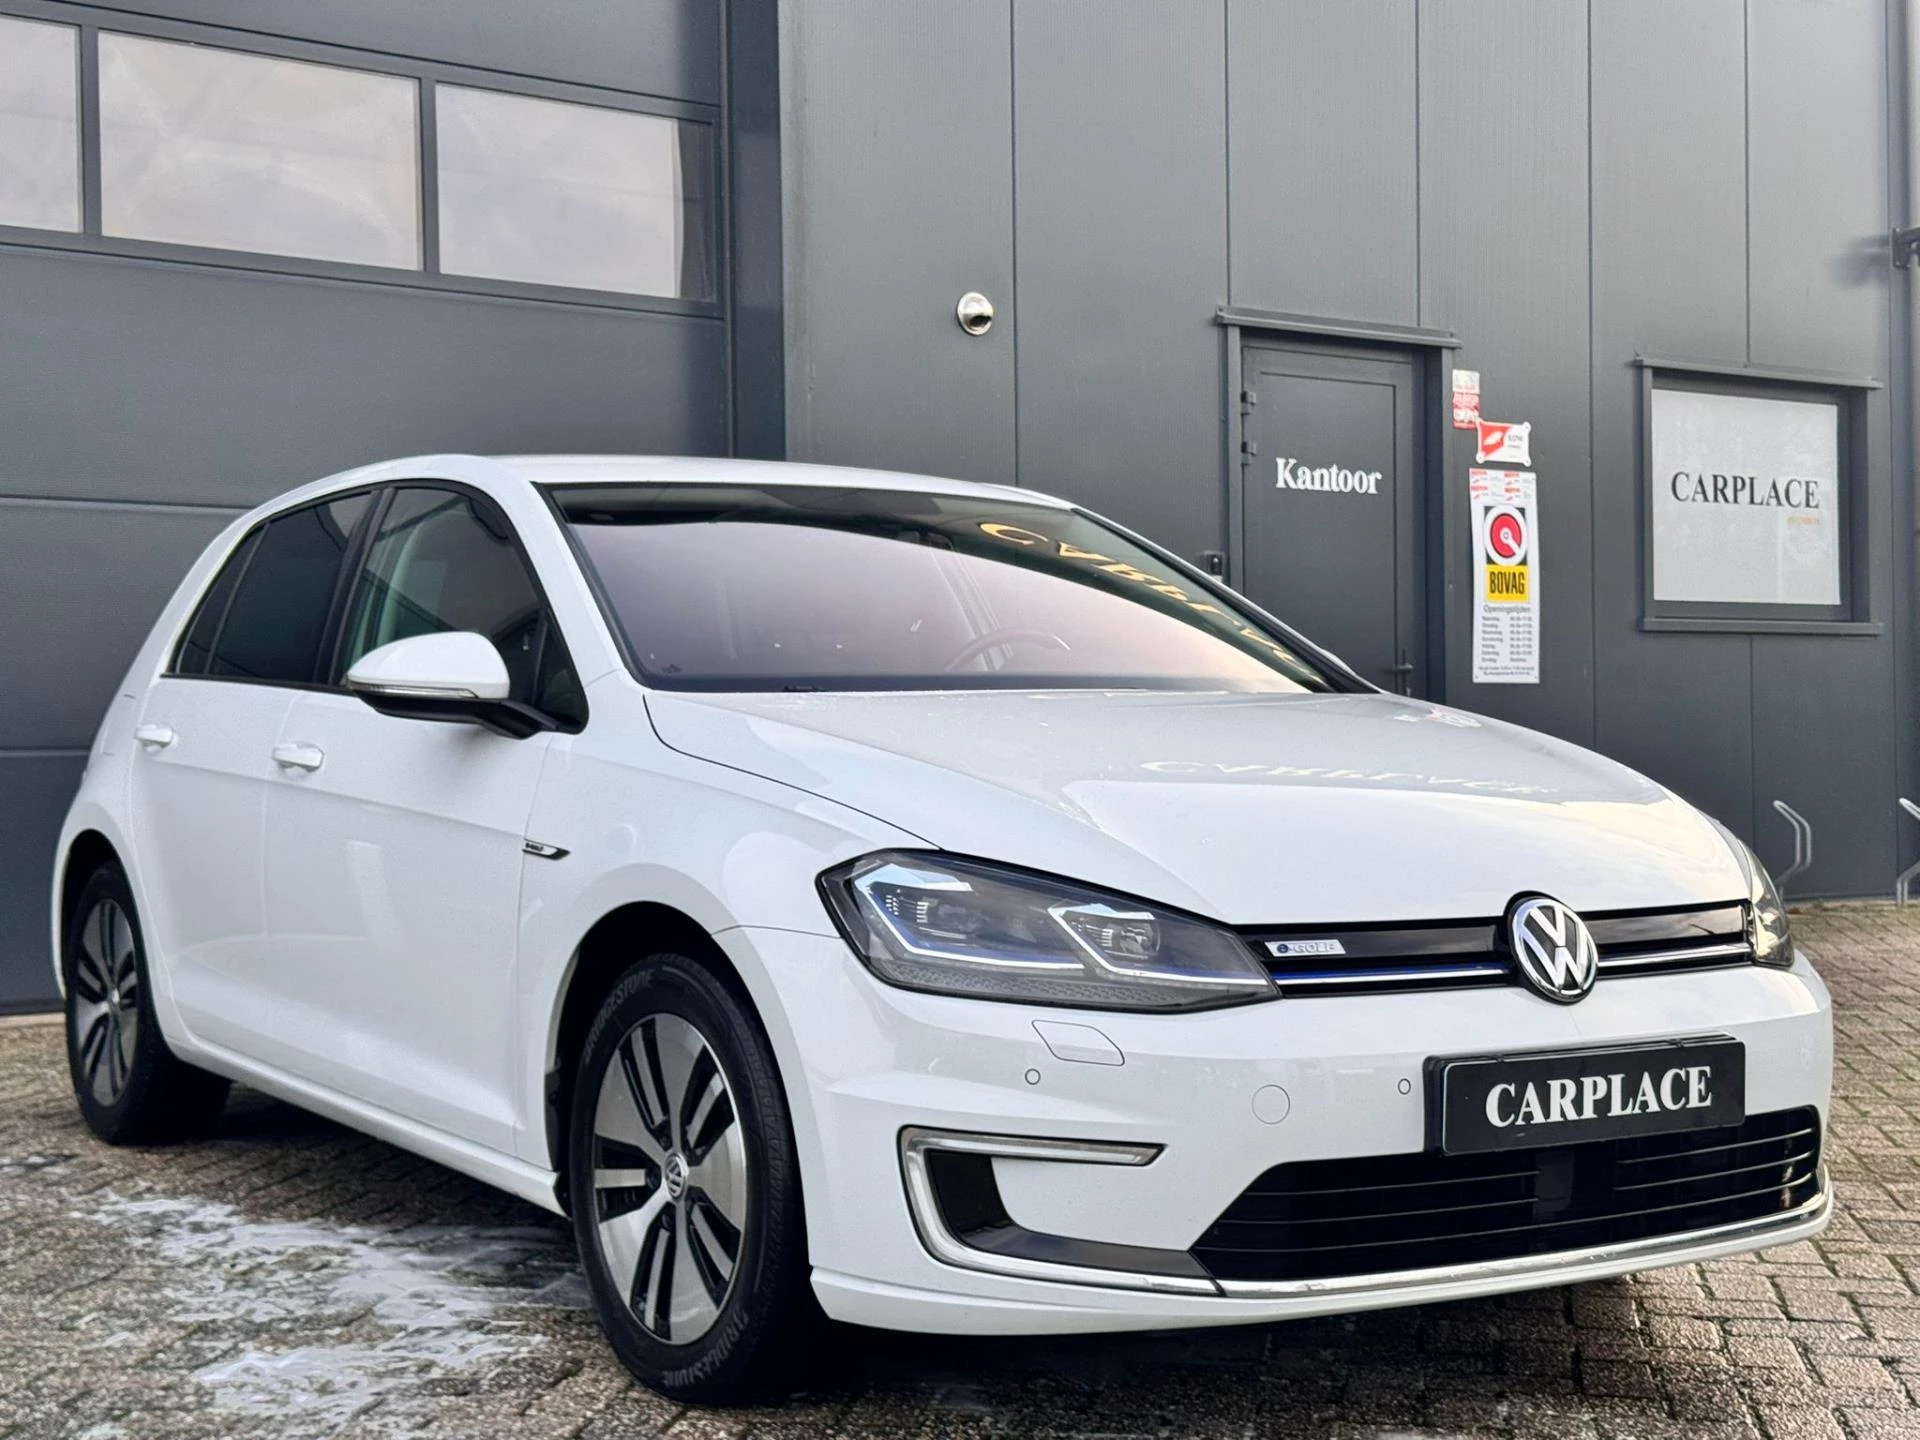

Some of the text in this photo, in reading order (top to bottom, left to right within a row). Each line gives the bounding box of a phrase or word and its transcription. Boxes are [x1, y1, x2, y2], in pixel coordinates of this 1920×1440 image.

[1275, 457, 1382, 494] Kantoor
[1671, 471, 1819, 509] CARPLACE
[1489, 571, 1525, 594] BOVAG
[1485, 1065, 1712, 1128] CARPLACE
